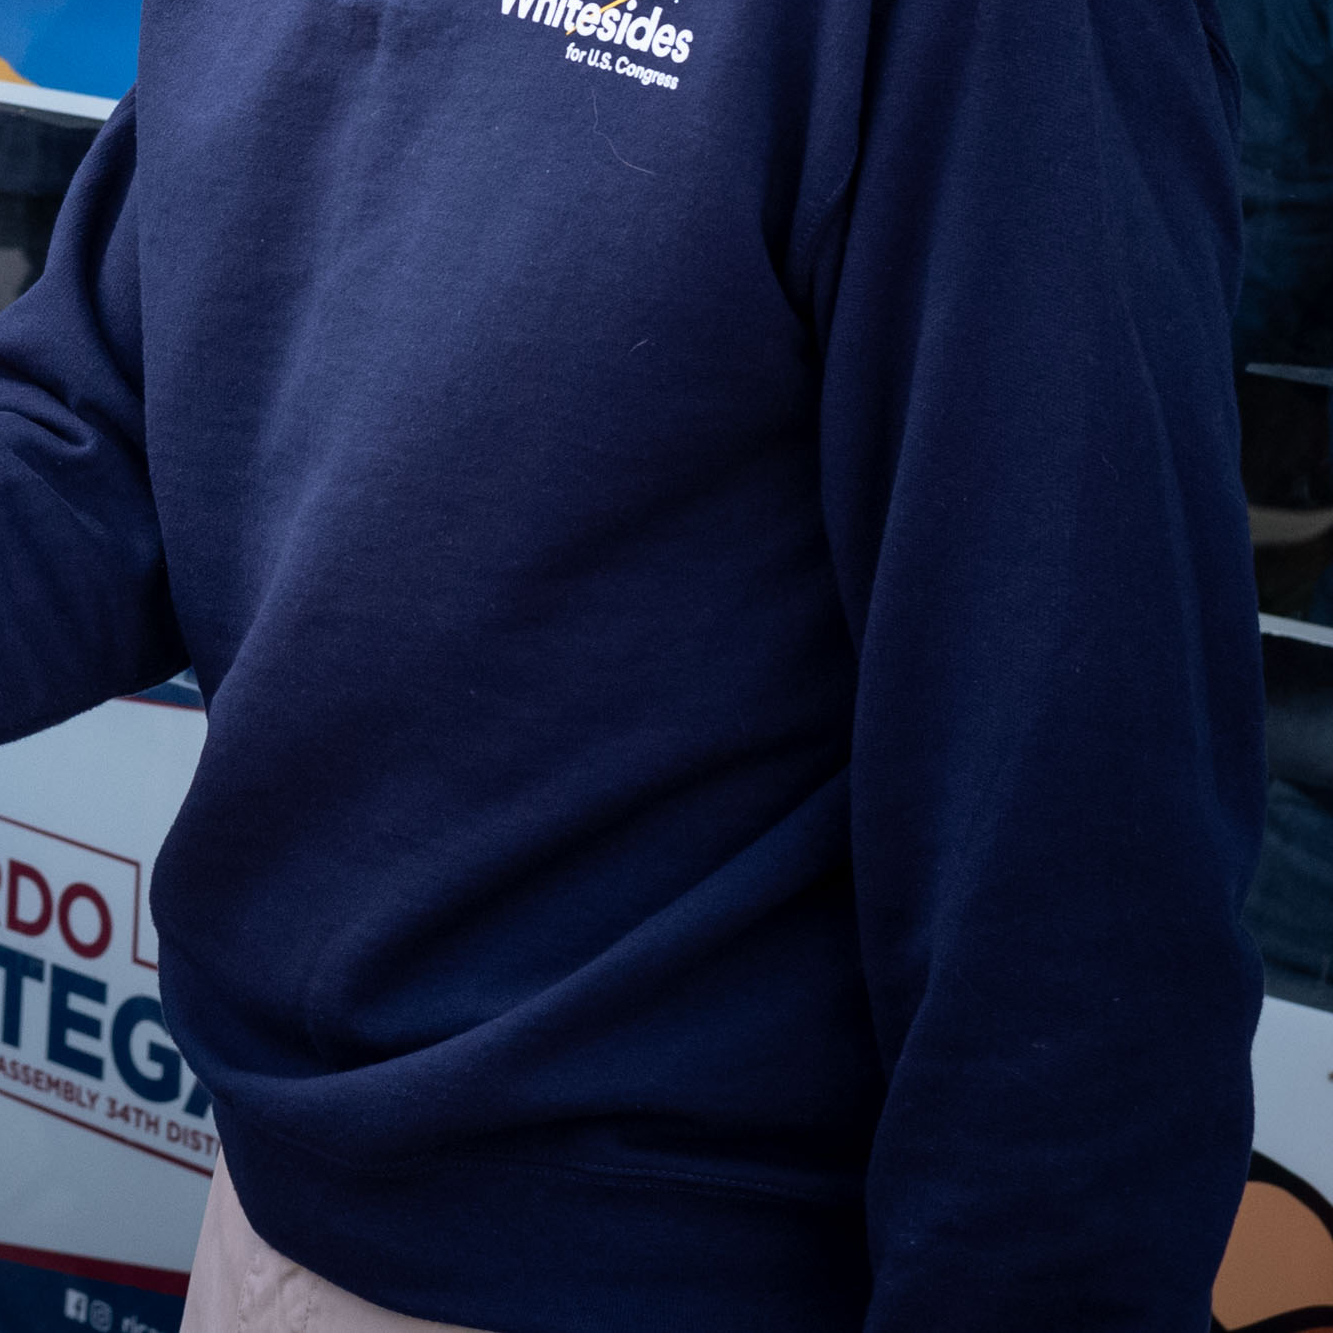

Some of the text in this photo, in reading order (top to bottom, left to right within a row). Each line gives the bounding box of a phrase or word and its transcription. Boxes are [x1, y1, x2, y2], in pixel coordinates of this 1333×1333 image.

[565, 42, 679, 90] for U.S. Congress
[105, 1096, 161, 1135] 34TH
